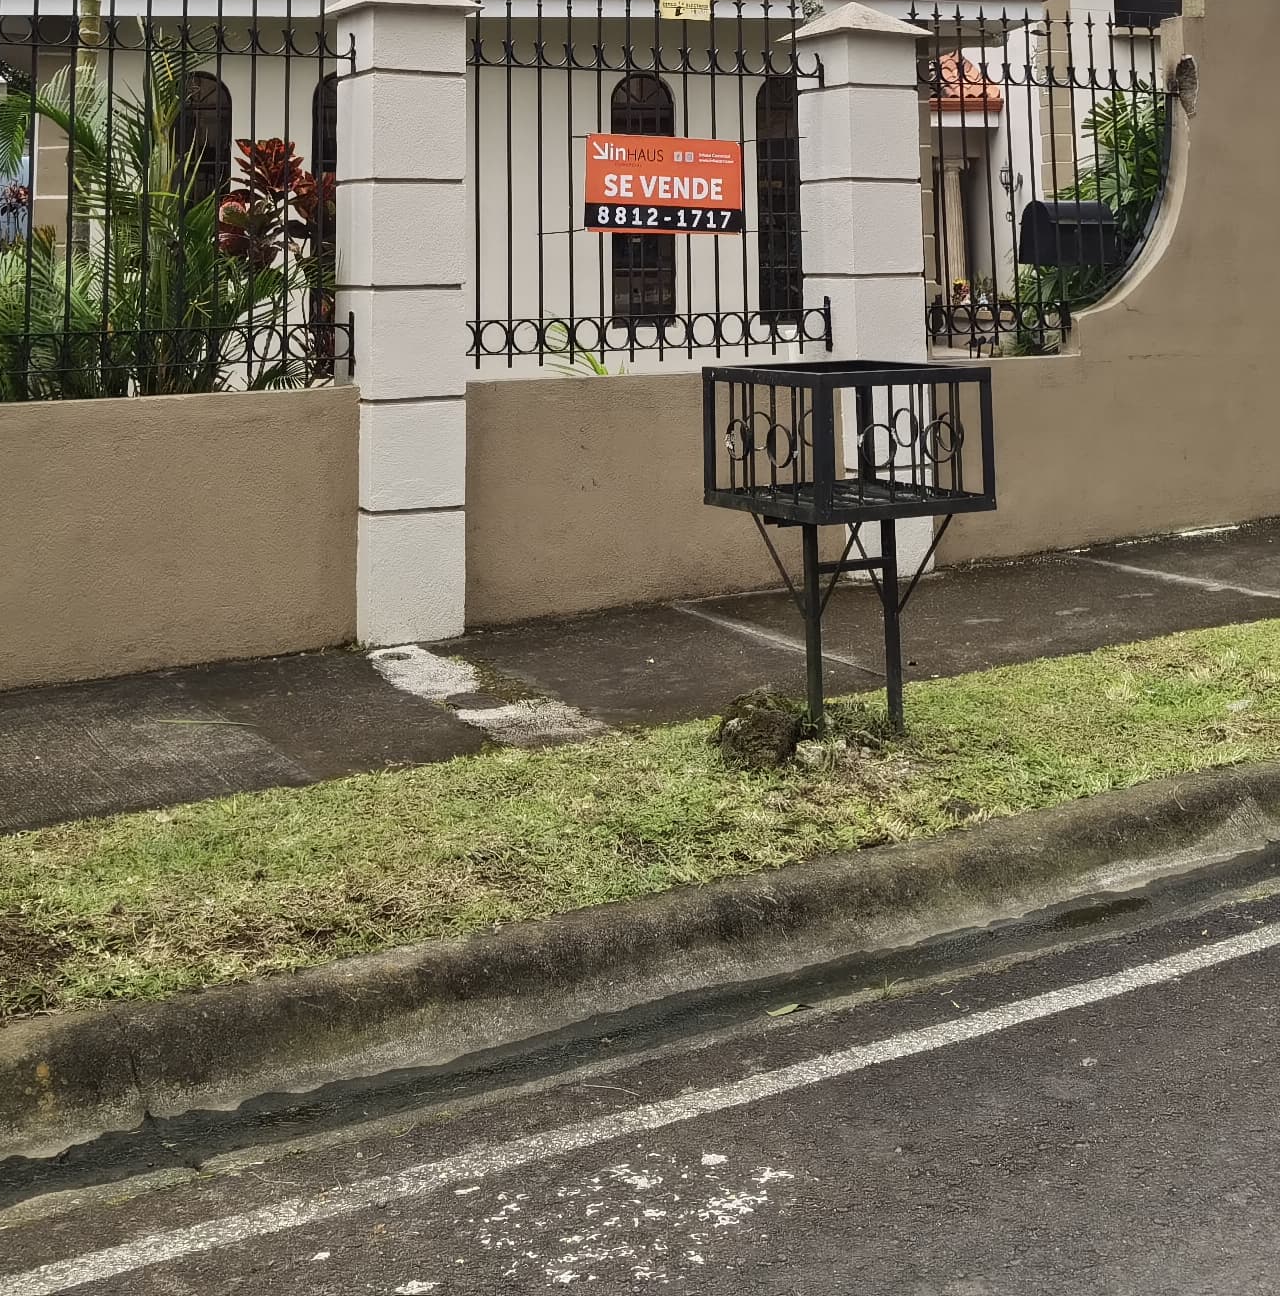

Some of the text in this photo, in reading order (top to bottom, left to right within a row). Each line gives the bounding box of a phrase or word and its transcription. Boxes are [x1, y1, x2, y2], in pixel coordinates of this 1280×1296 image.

[604, 173, 723, 201] SE VENDE
[597, 205, 732, 229] 8812-1717
